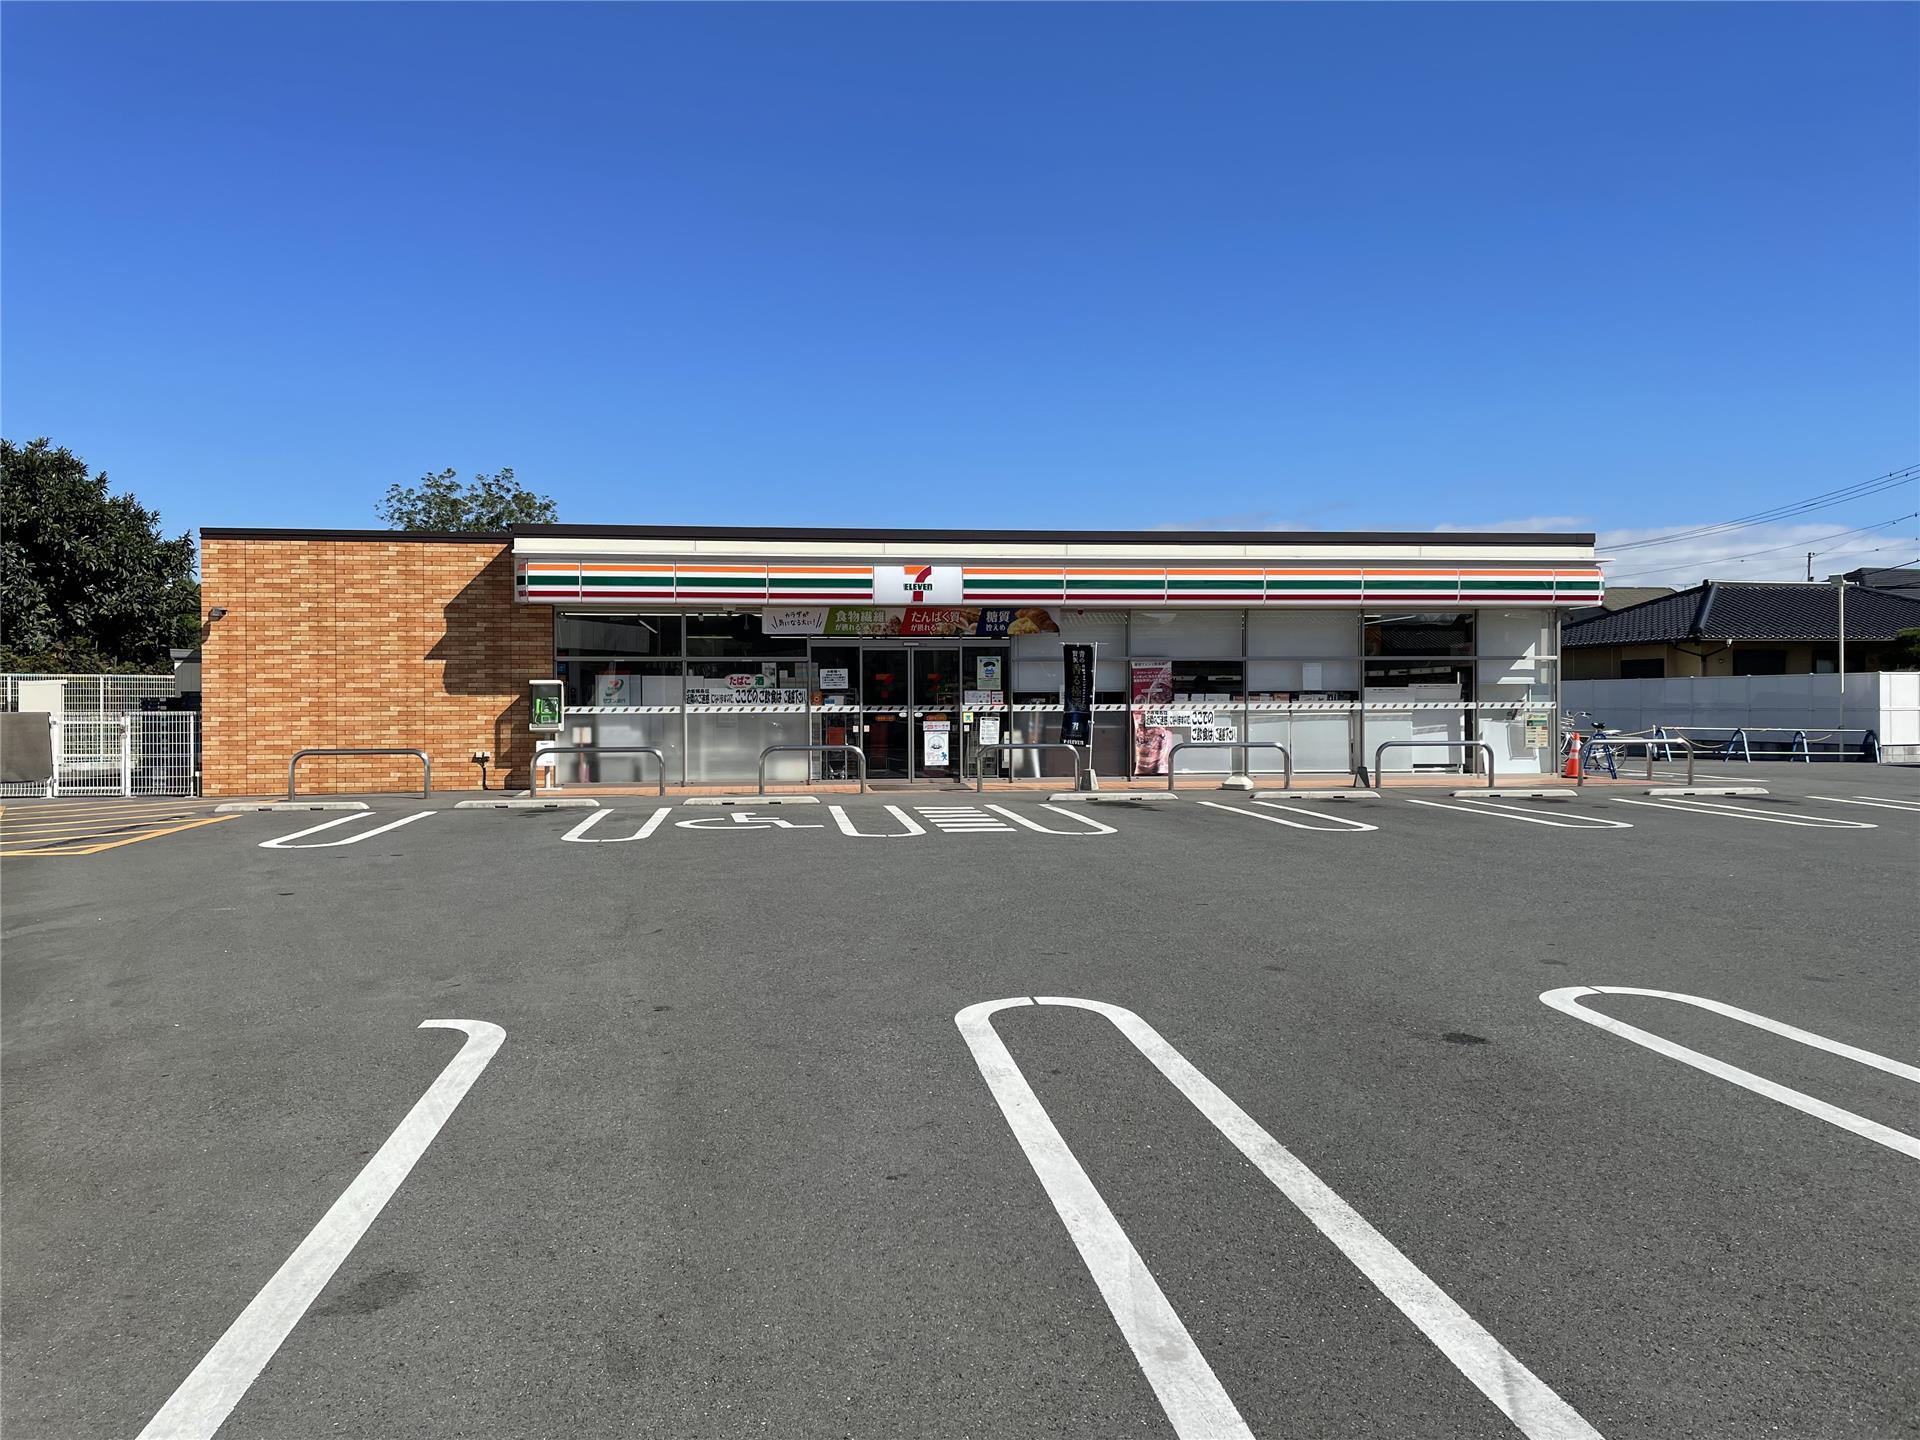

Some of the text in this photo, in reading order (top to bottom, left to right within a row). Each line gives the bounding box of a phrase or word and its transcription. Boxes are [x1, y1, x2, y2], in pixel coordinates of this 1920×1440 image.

[904, 565, 932, 601] 7
[785, 610, 810, 618] カラダが
[835, 610, 885, 623] 食物繊維
[911, 610, 961, 623] たんぱく質
[986, 610, 1010, 623] 糖質
[729, 676, 765, 686] たばこ 酒
[1191, 711, 1214, 725] ここでの
